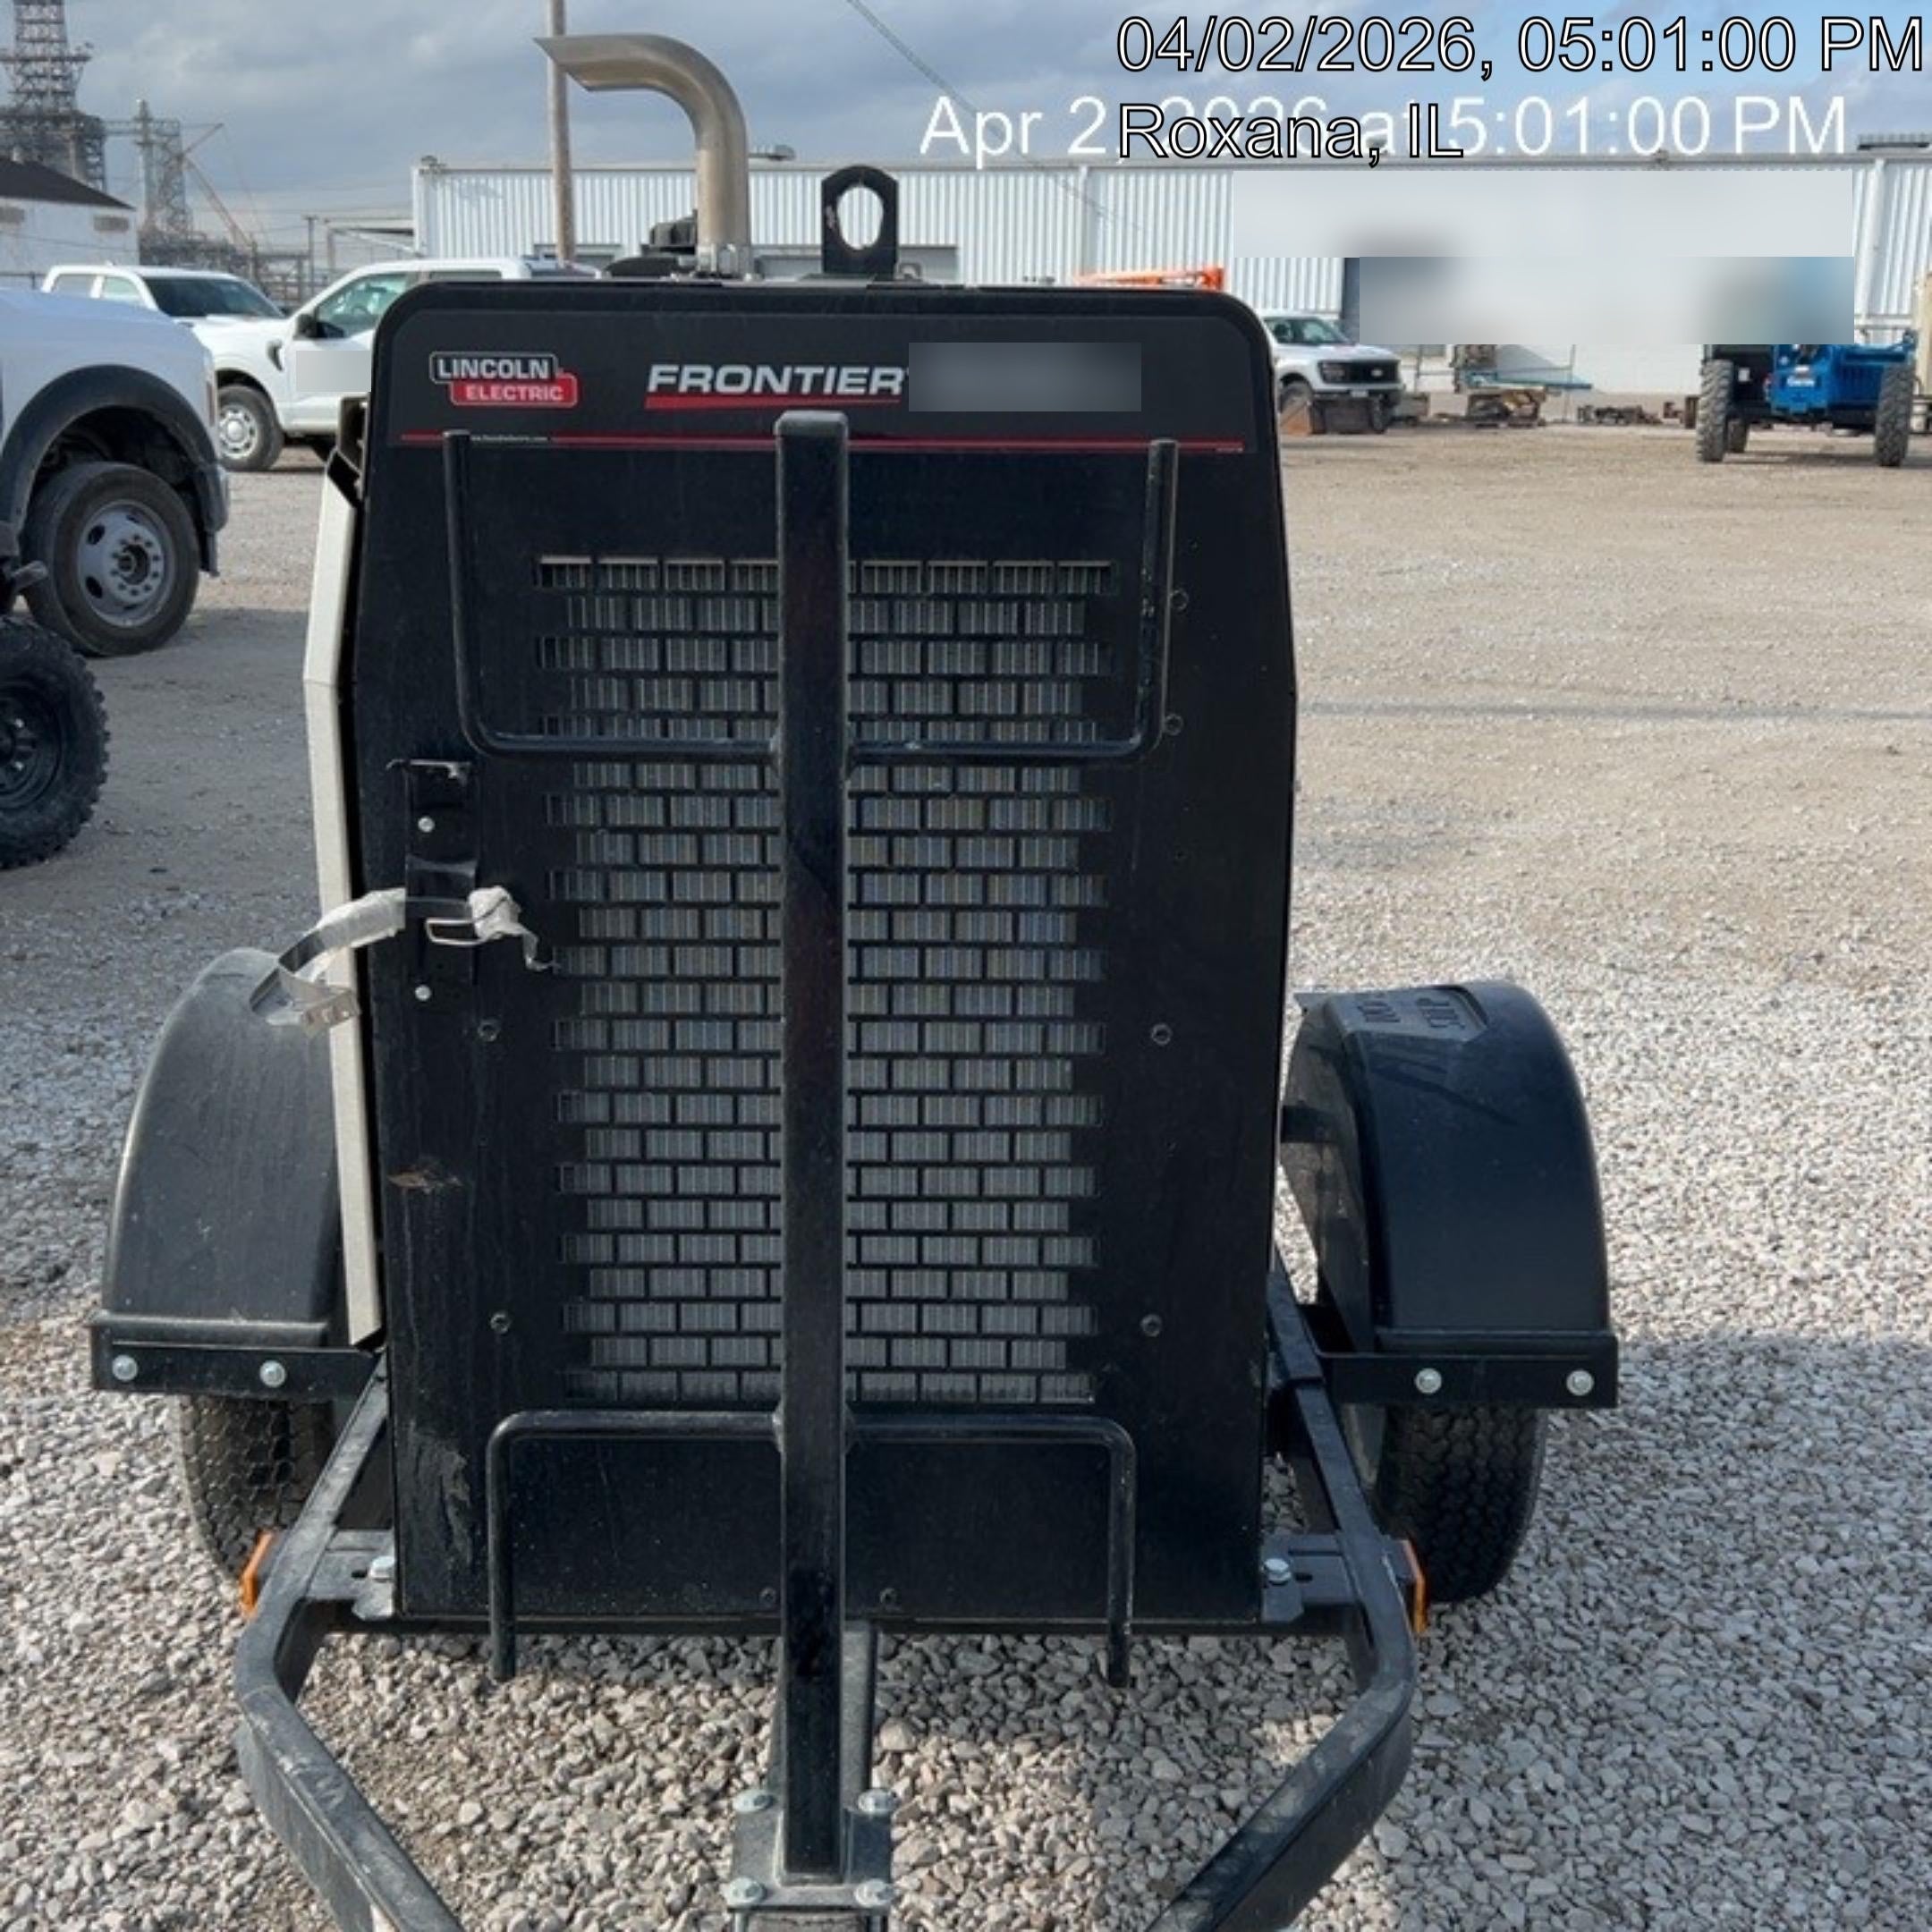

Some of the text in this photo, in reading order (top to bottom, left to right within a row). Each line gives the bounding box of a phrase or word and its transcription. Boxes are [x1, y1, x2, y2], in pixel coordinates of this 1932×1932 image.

[437, 359, 549, 379] LINCOLN
[648, 363, 906, 395] FRONTIER
[465, 385, 564, 402] ELECTRIC
